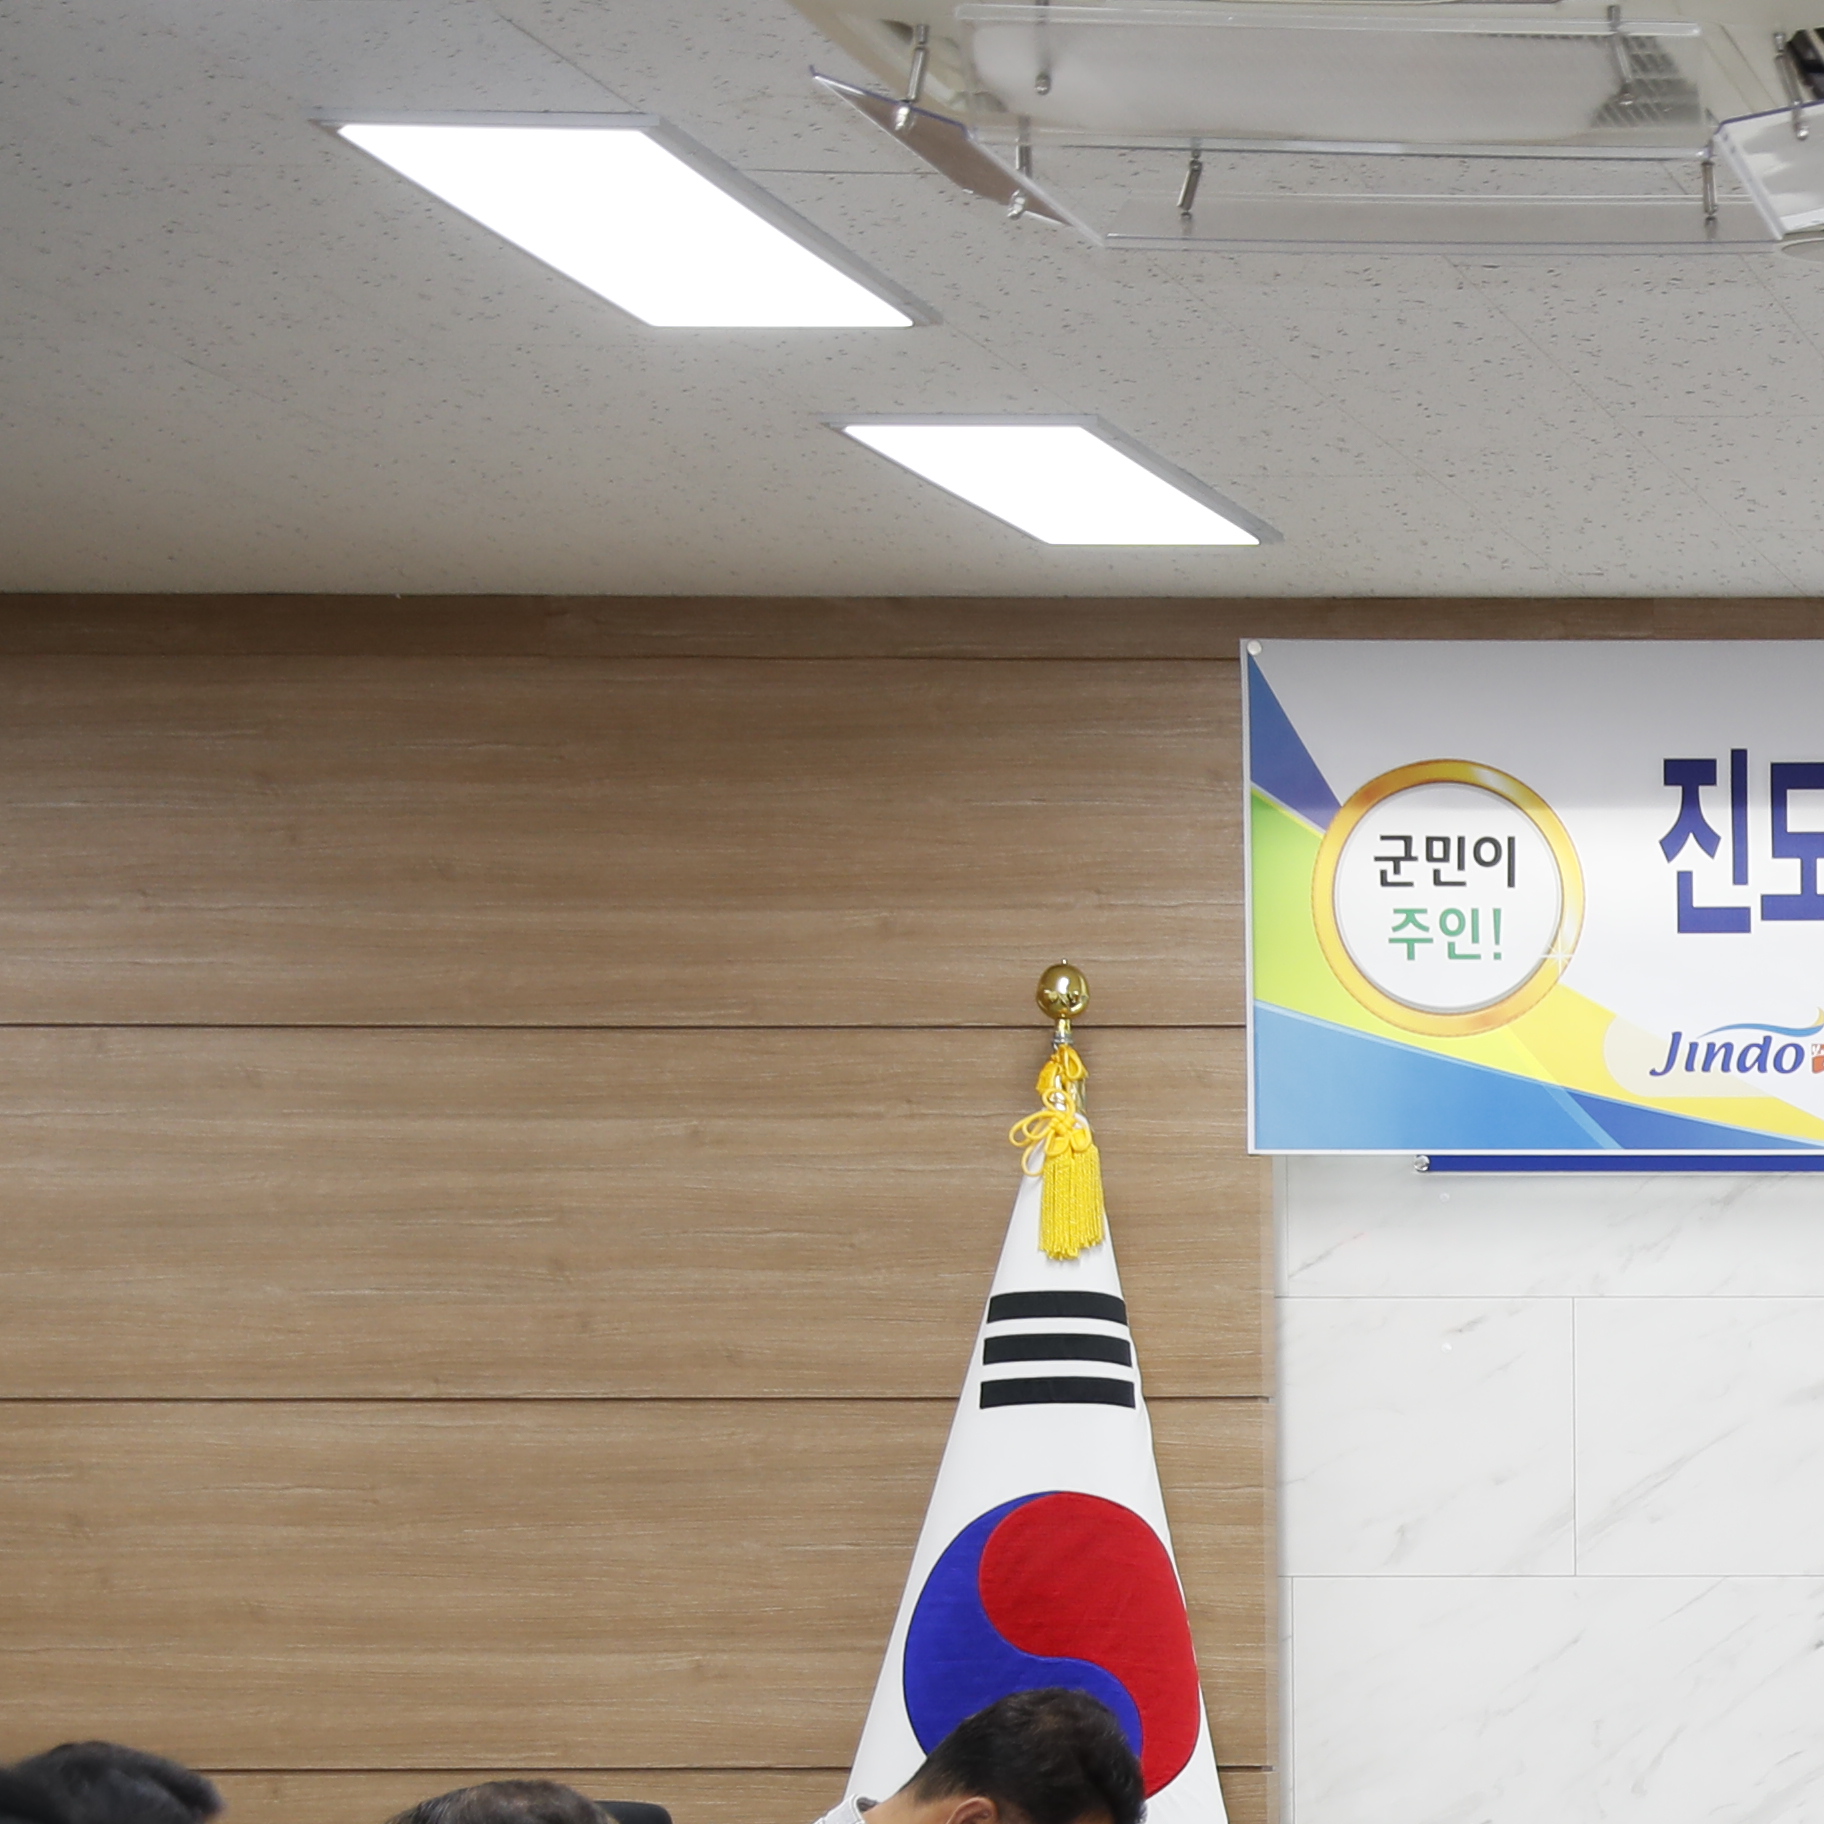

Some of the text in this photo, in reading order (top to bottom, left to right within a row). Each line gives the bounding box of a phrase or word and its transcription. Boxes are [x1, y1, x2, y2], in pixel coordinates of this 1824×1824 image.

[1373, 833, 1517, 889] 군민이
[1388, 906, 1503, 962] 주인!
[1649, 1031, 1805, 1077] Jindo
